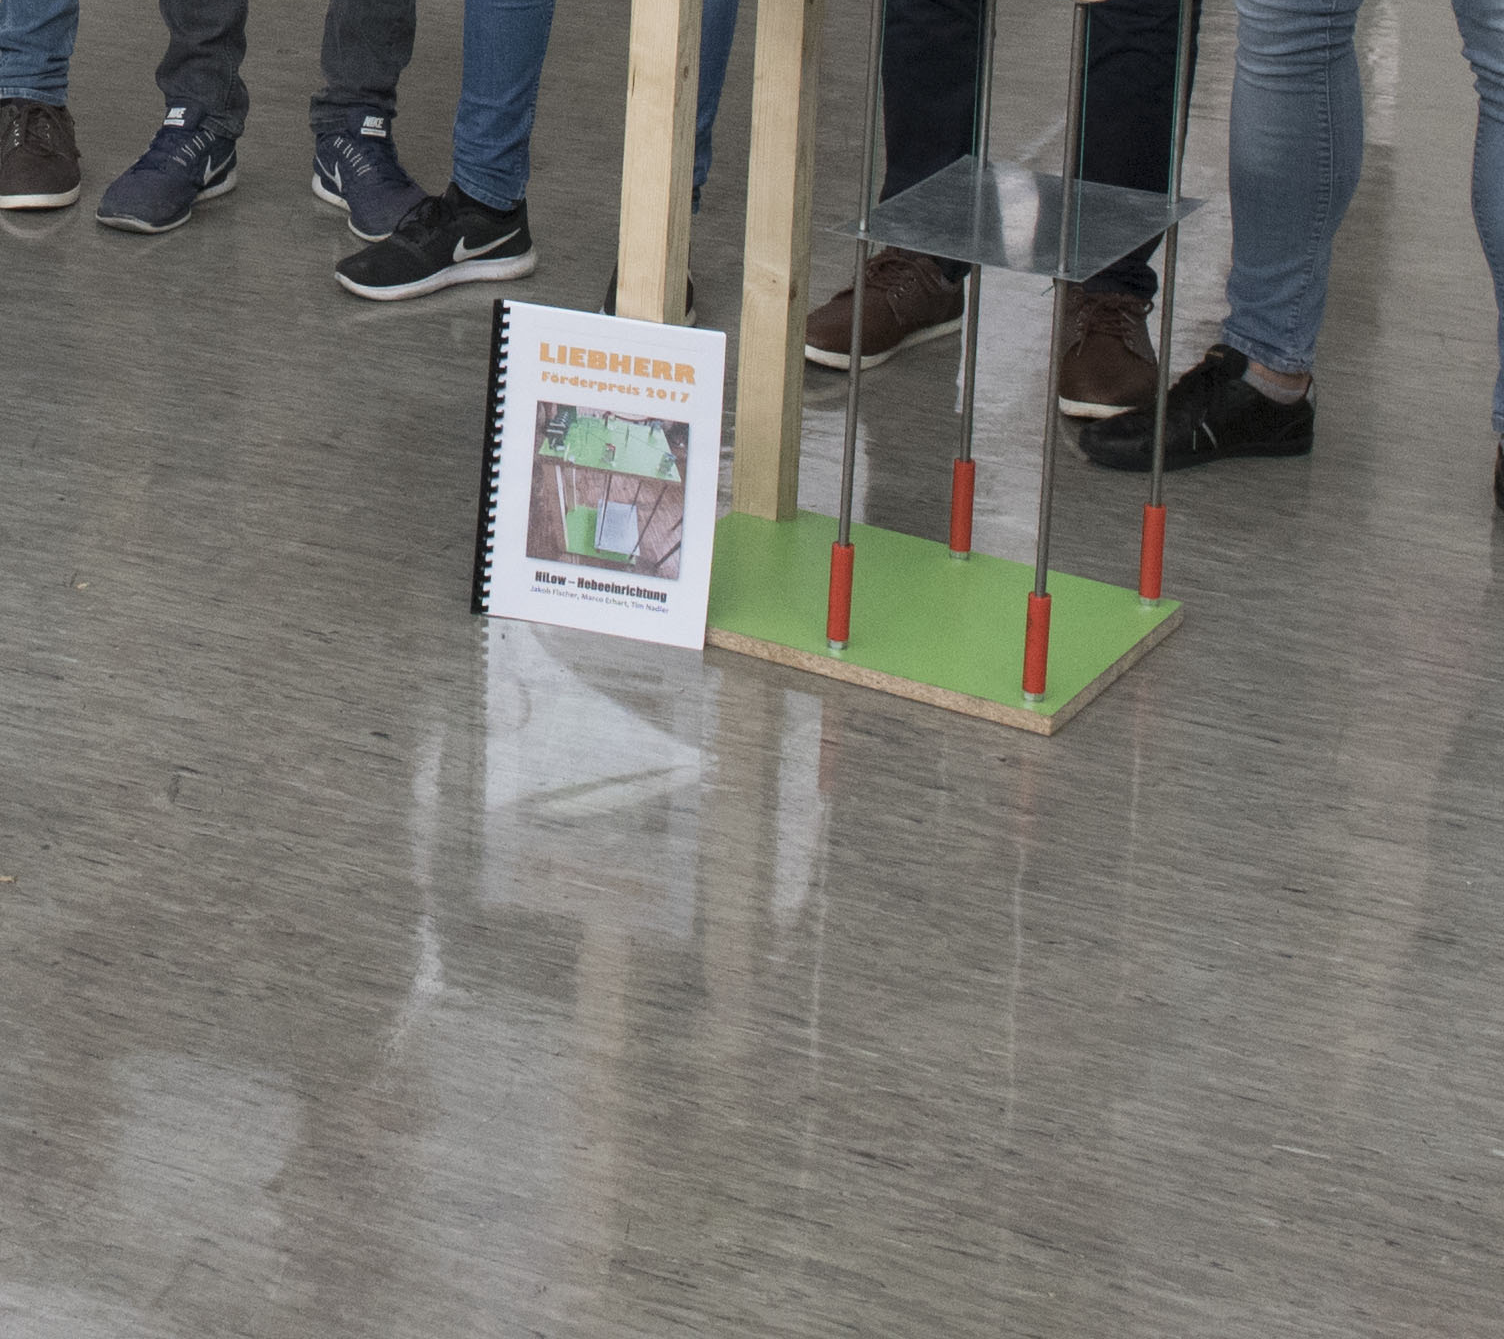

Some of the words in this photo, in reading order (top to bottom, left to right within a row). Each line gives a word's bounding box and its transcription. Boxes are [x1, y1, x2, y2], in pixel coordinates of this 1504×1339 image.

[362, 115, 385, 129] NIKE
[539, 342, 696, 386] LIEBHERR
[541, 370, 641, 397] Förderpreis
[645, 386, 690, 404] 2017
[530, 585, 552, 596] Jakob
[552, 588, 580, 601] Fischer,
[581, 592, 604, 603] Marco
[605, 596, 630, 609] Erhart,
[631, 599, 644, 610] Tim
[645, 602, 670, 614] Nadler
[535, 570, 567, 586] HiLow
[577, 577, 668, 603] Hebeeinrichtung
